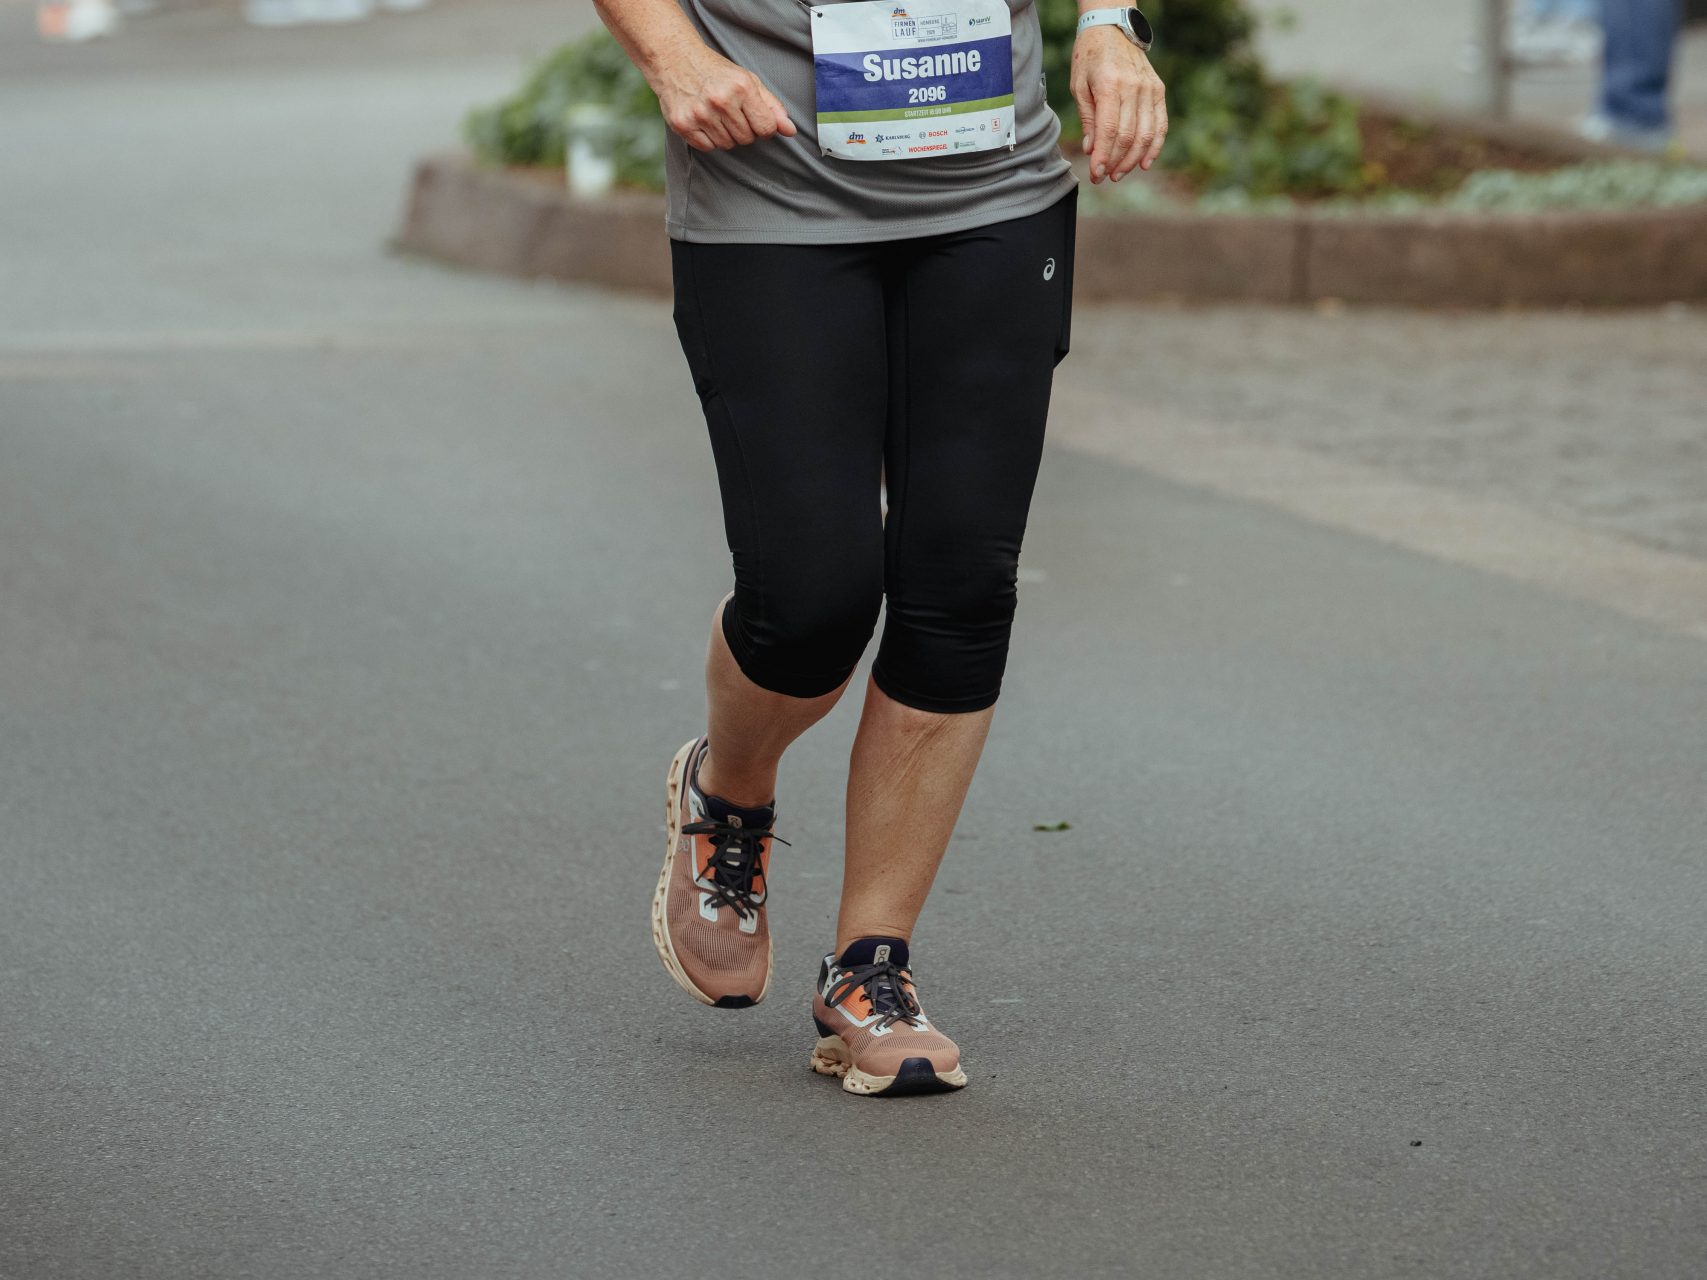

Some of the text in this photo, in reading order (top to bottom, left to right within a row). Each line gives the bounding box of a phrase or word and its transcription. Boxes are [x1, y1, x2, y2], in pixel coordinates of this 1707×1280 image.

[894, 28, 916, 37] LAUF
[863, 49, 981, 82] Susanne
[908, 85, 947, 103] 2096
[849, 131, 864, 140] dm
[928, 129, 948, 137] BOSCH
